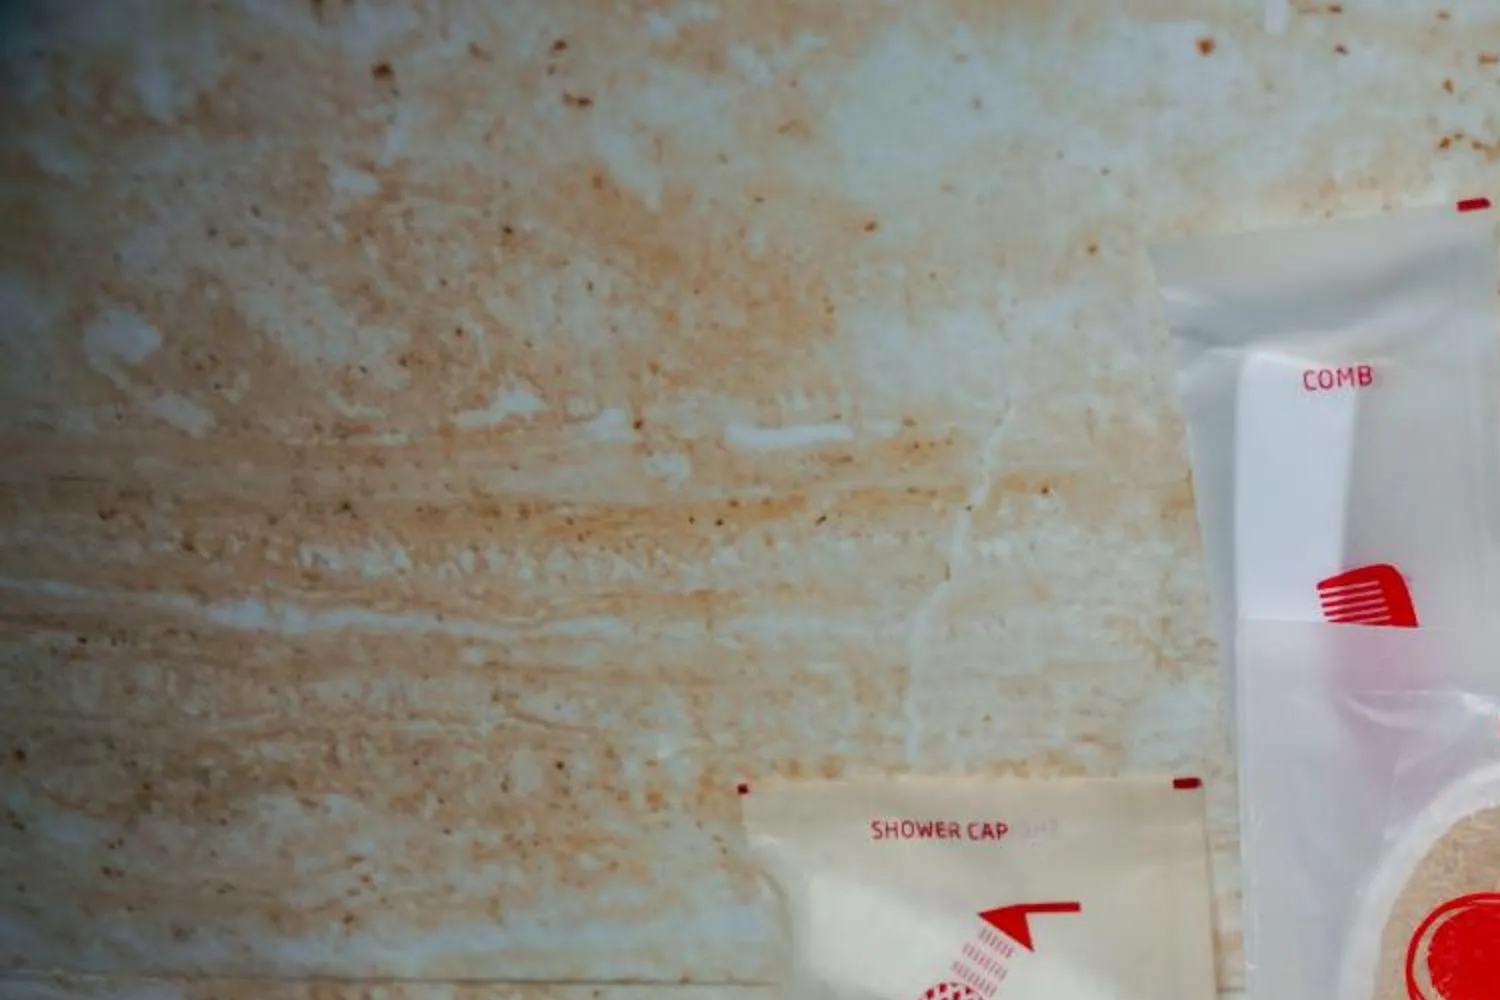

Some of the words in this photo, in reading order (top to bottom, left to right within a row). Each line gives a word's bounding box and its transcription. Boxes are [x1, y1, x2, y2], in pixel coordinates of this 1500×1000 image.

[1303, 365, 1373, 392] COMB
[870, 819, 961, 840] SHOWER
[966, 821, 1009, 841] CAP
